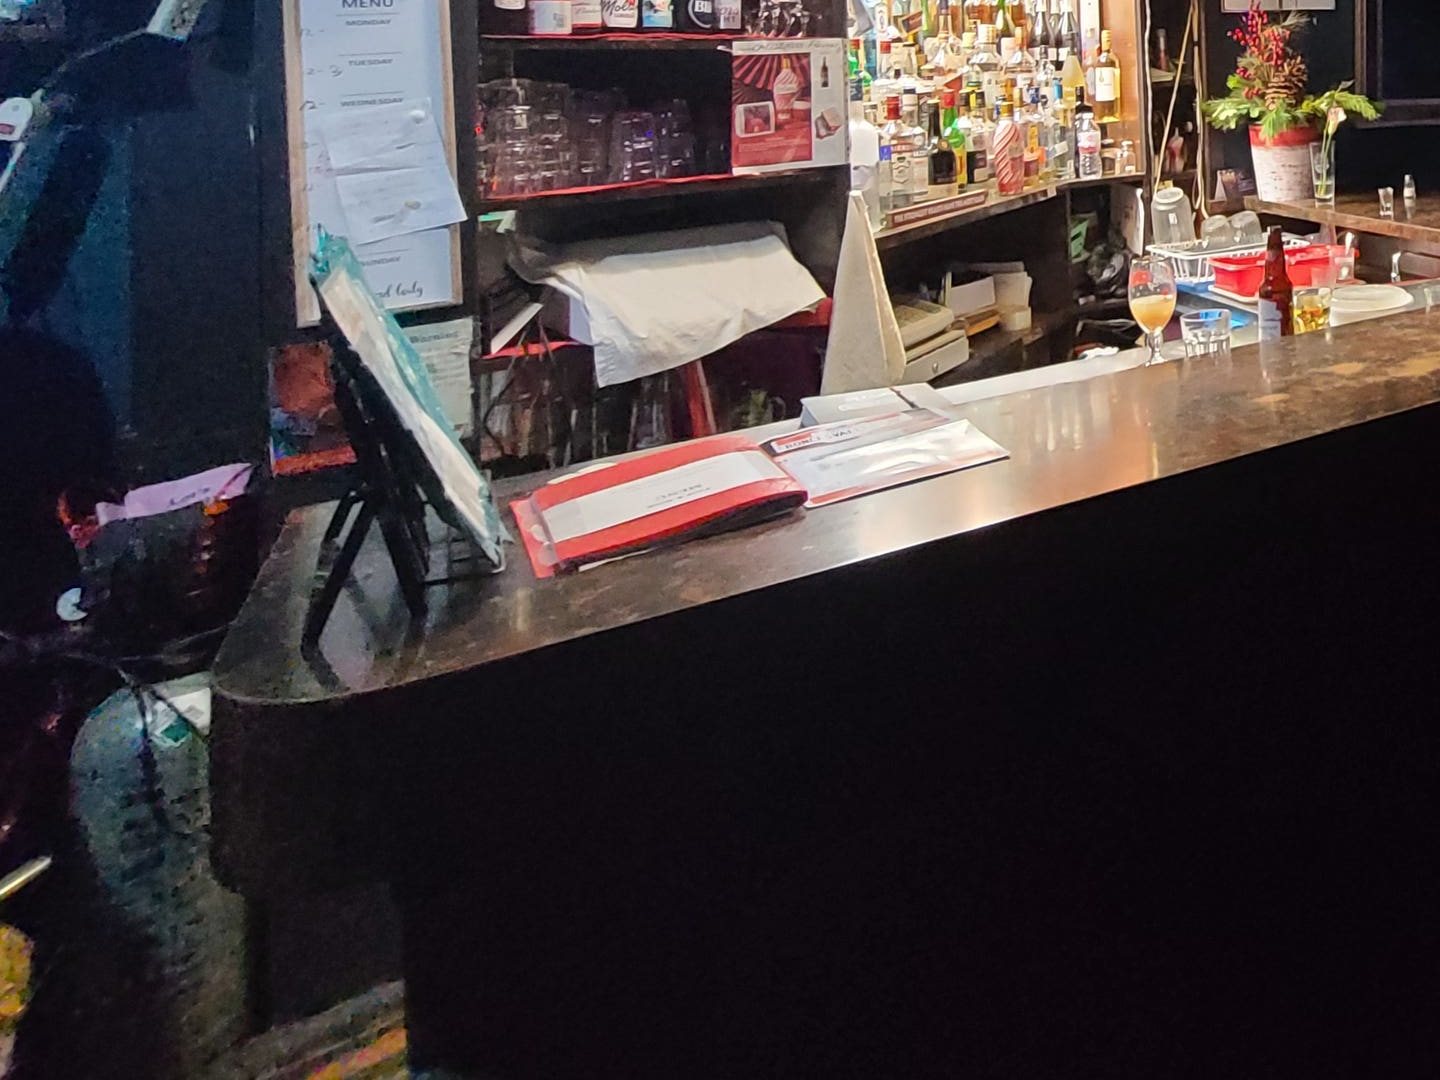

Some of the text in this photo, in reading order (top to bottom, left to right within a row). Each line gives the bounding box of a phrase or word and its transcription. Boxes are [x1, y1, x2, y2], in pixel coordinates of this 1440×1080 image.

[345, 19, 391, 27] MONDAY
[348, 58, 393, 67] TUESDAY
[340, 97, 404, 108] WEDNESDAY
